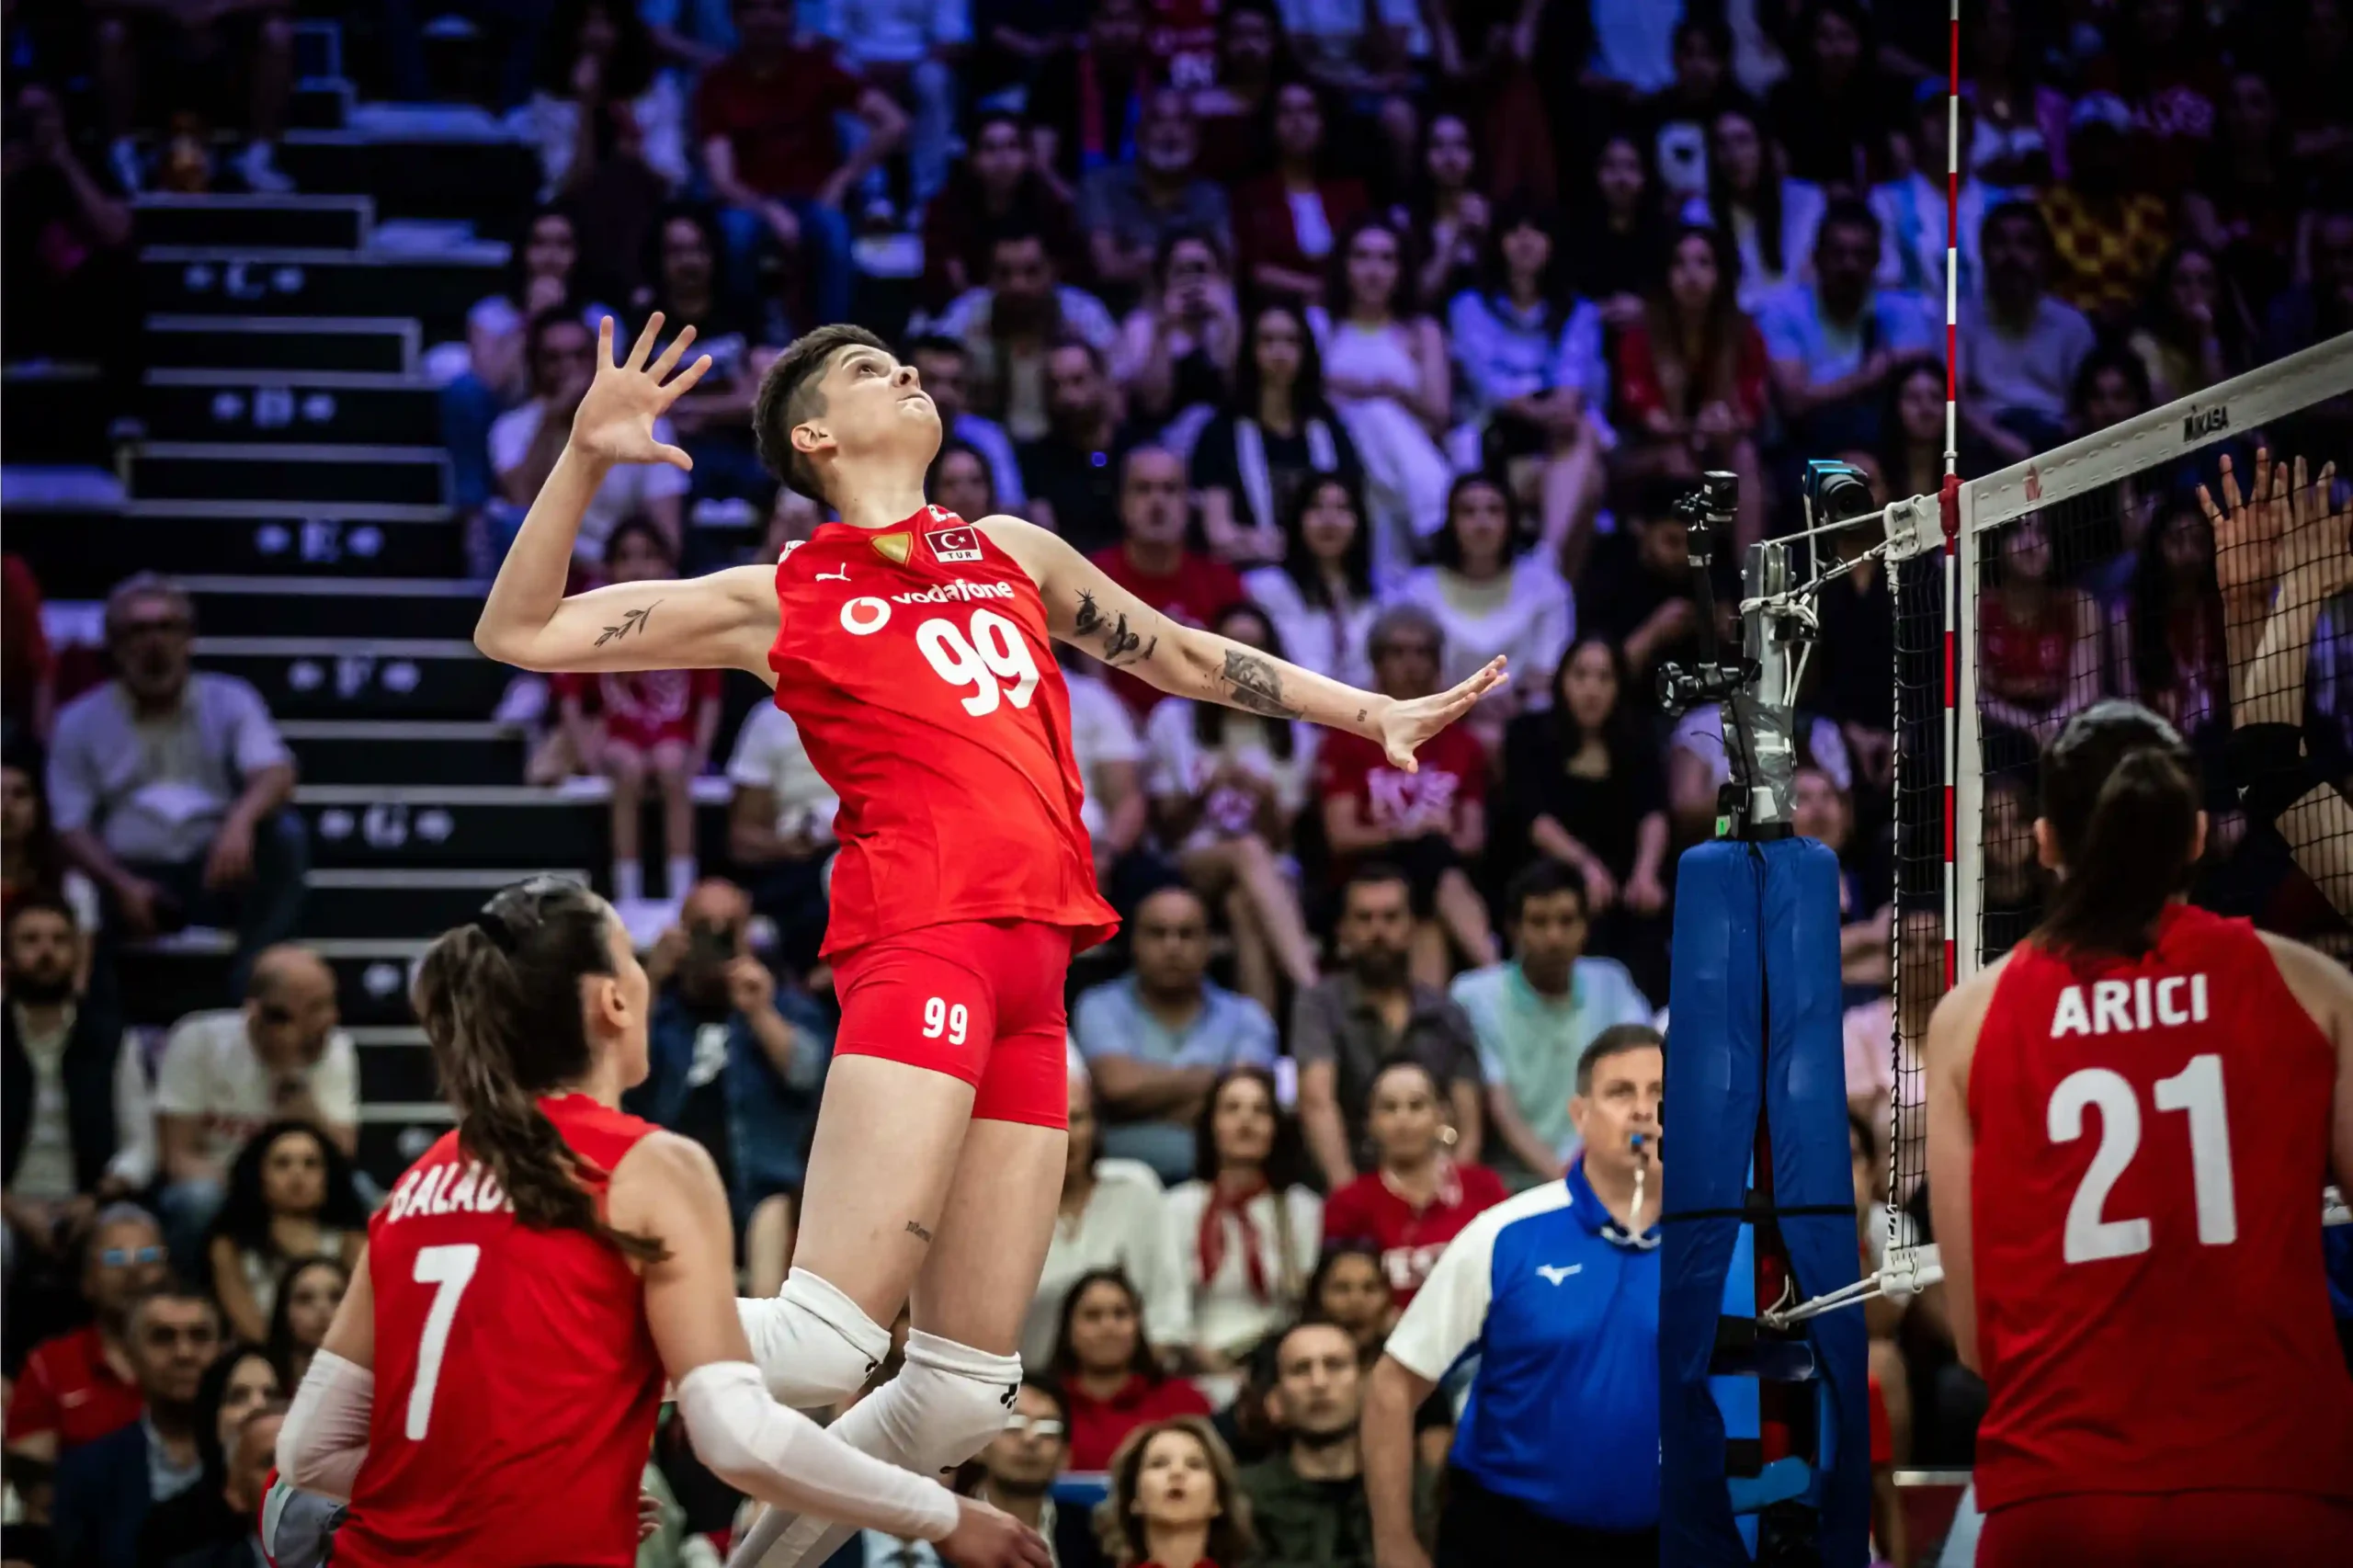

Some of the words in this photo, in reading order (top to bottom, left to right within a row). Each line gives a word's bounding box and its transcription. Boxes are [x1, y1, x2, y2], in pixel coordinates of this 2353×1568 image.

[948, 551, 972, 560] TUR
[892, 579, 1015, 604] vodafone
[915, 608, 1040, 716] 99
[922, 996, 968, 1045] 99
[2050, 973, 2209, 1039] ARICI
[2047, 1053, 2237, 1265] 21
[405, 1244, 481, 1440] 7
